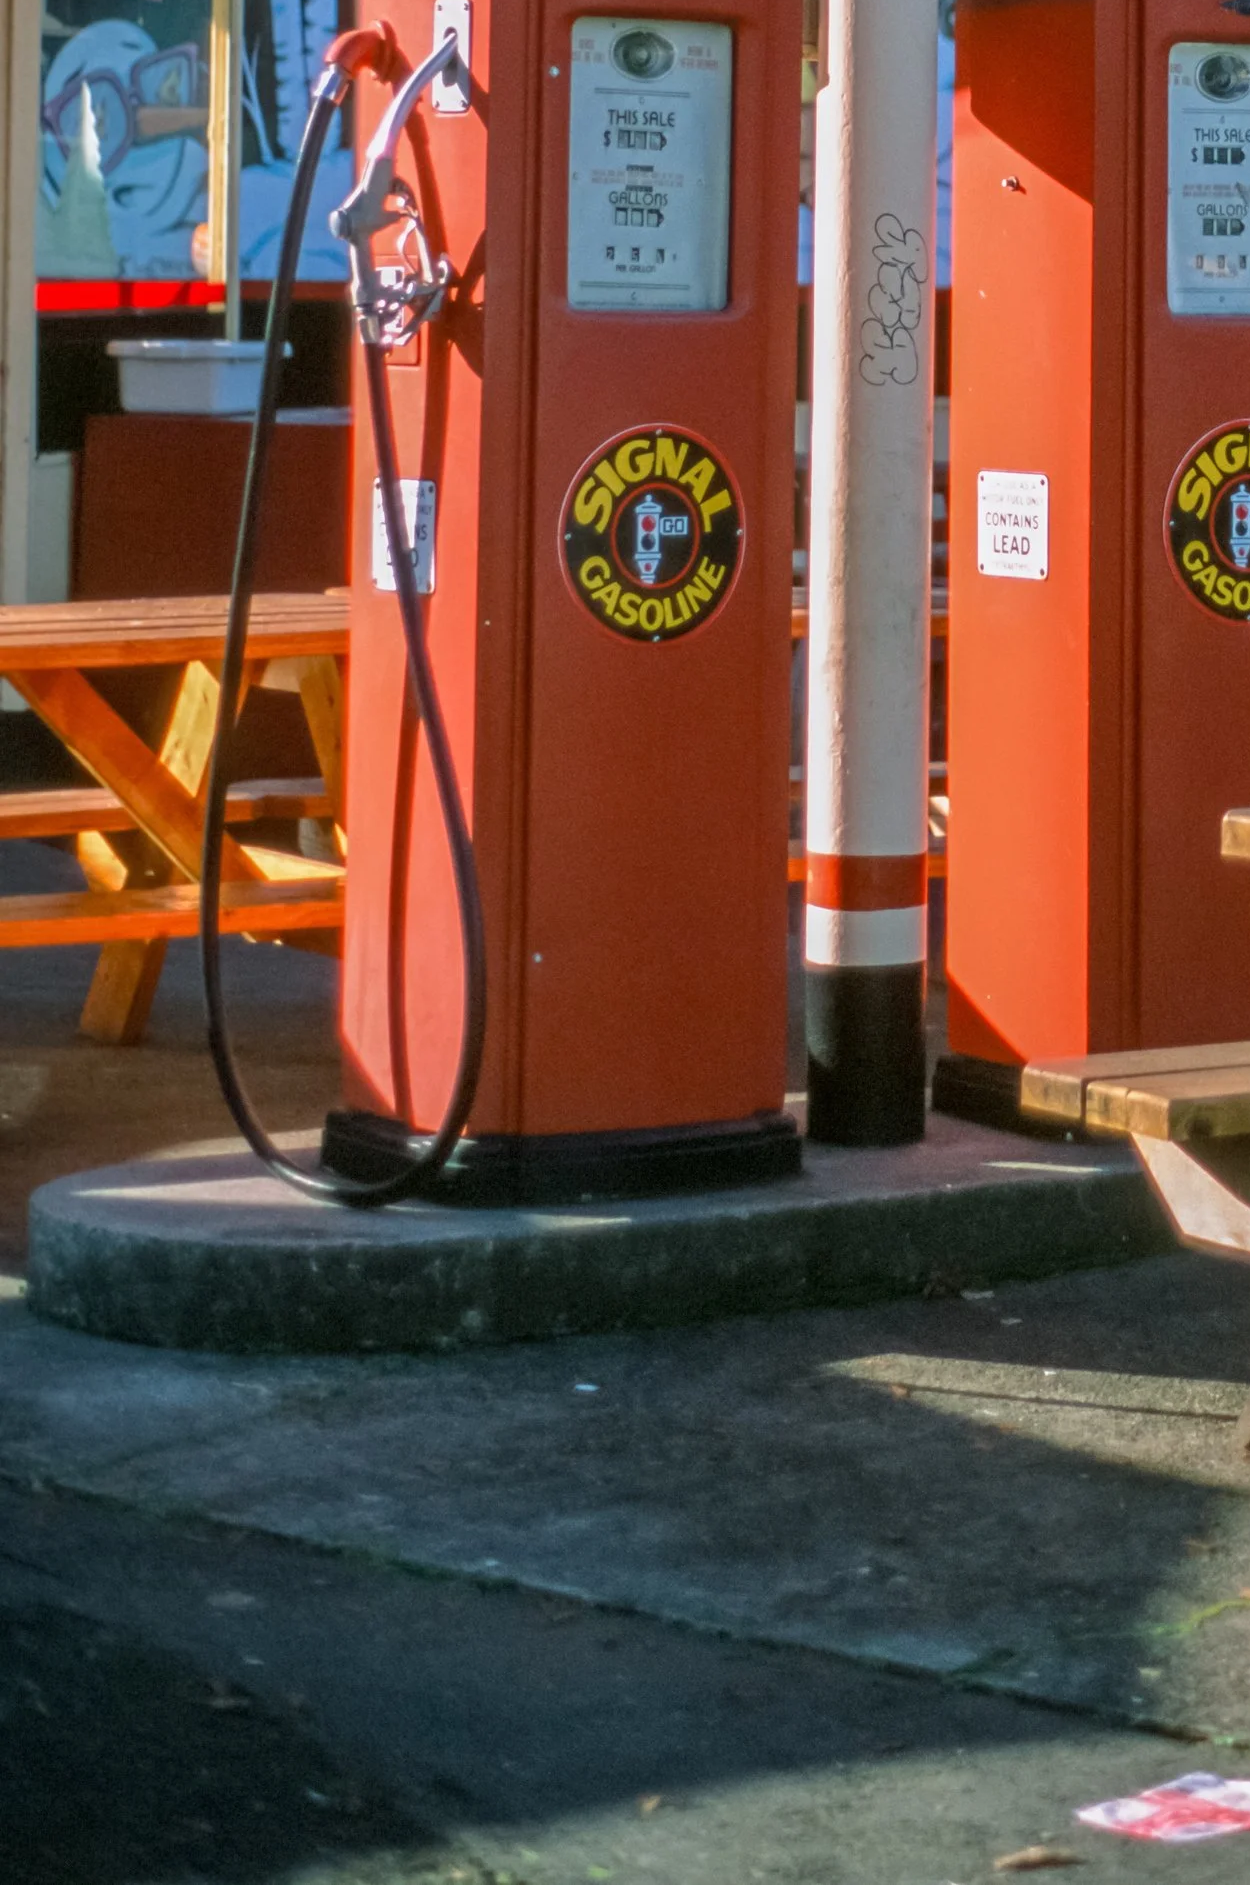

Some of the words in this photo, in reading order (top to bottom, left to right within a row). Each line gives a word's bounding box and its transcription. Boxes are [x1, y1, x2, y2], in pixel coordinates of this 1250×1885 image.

[608, 109, 638, 127] THIS
[642, 111, 676, 128] SALE
[1194, 128, 1221, 143] THIS
[608, 191, 668, 206] GALLONS
[1197, 204, 1249, 217] GALLONS
[574, 437, 732, 534] SIGNAL
[663, 518, 685, 533] GO
[985, 512, 1039, 530] CONTAINS
[993, 535, 1030, 555] LEAD
[580, 555, 726, 631] GASOLINE
